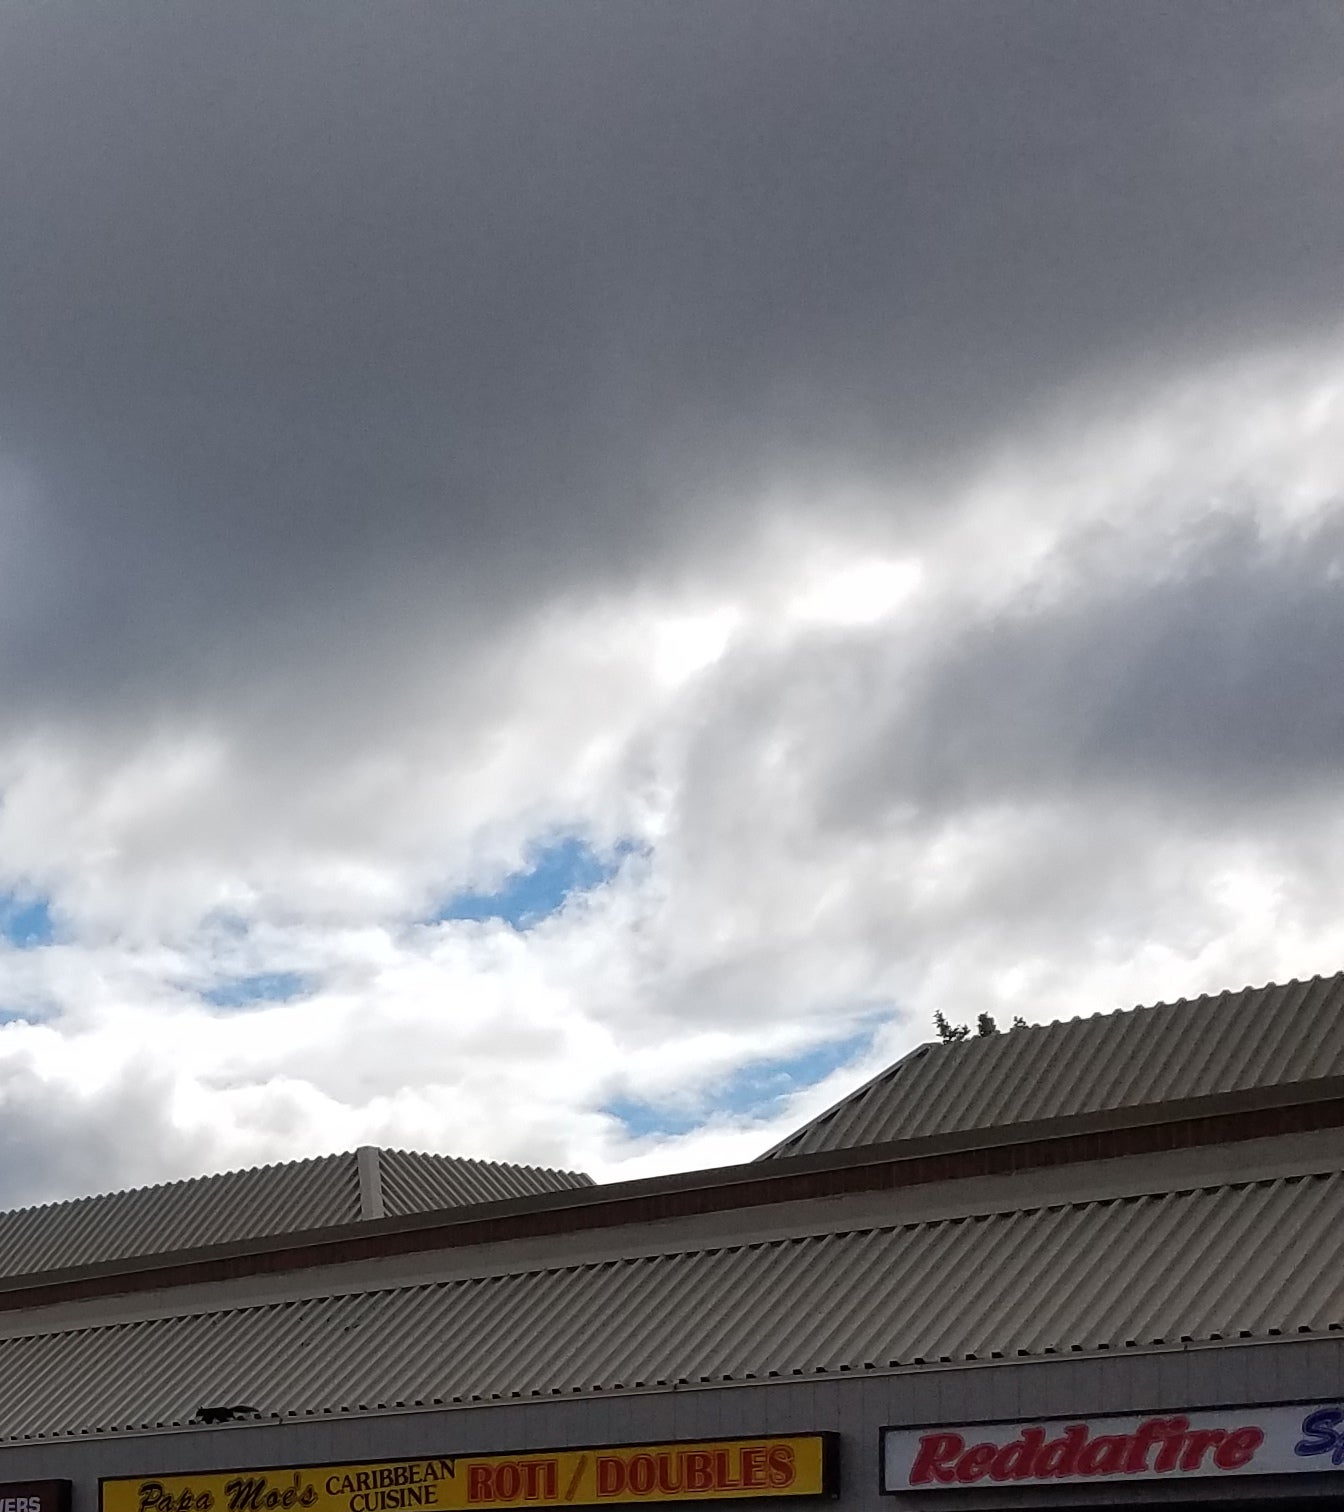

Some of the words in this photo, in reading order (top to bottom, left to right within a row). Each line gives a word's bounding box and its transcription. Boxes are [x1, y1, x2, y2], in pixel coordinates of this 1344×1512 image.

[910, 1415, 1264, 1485] Reddafire
[1294, 1406, 1344, 1466] S
[225, 1472, 318, 1512] Moe's
[326, 1457, 456, 1496] CARIBBEAN
[468, 1459, 558, 1503] ROTI
[596, 1444, 796, 1497] DOUBLES
[350, 1485, 438, 1512] CUISINE
